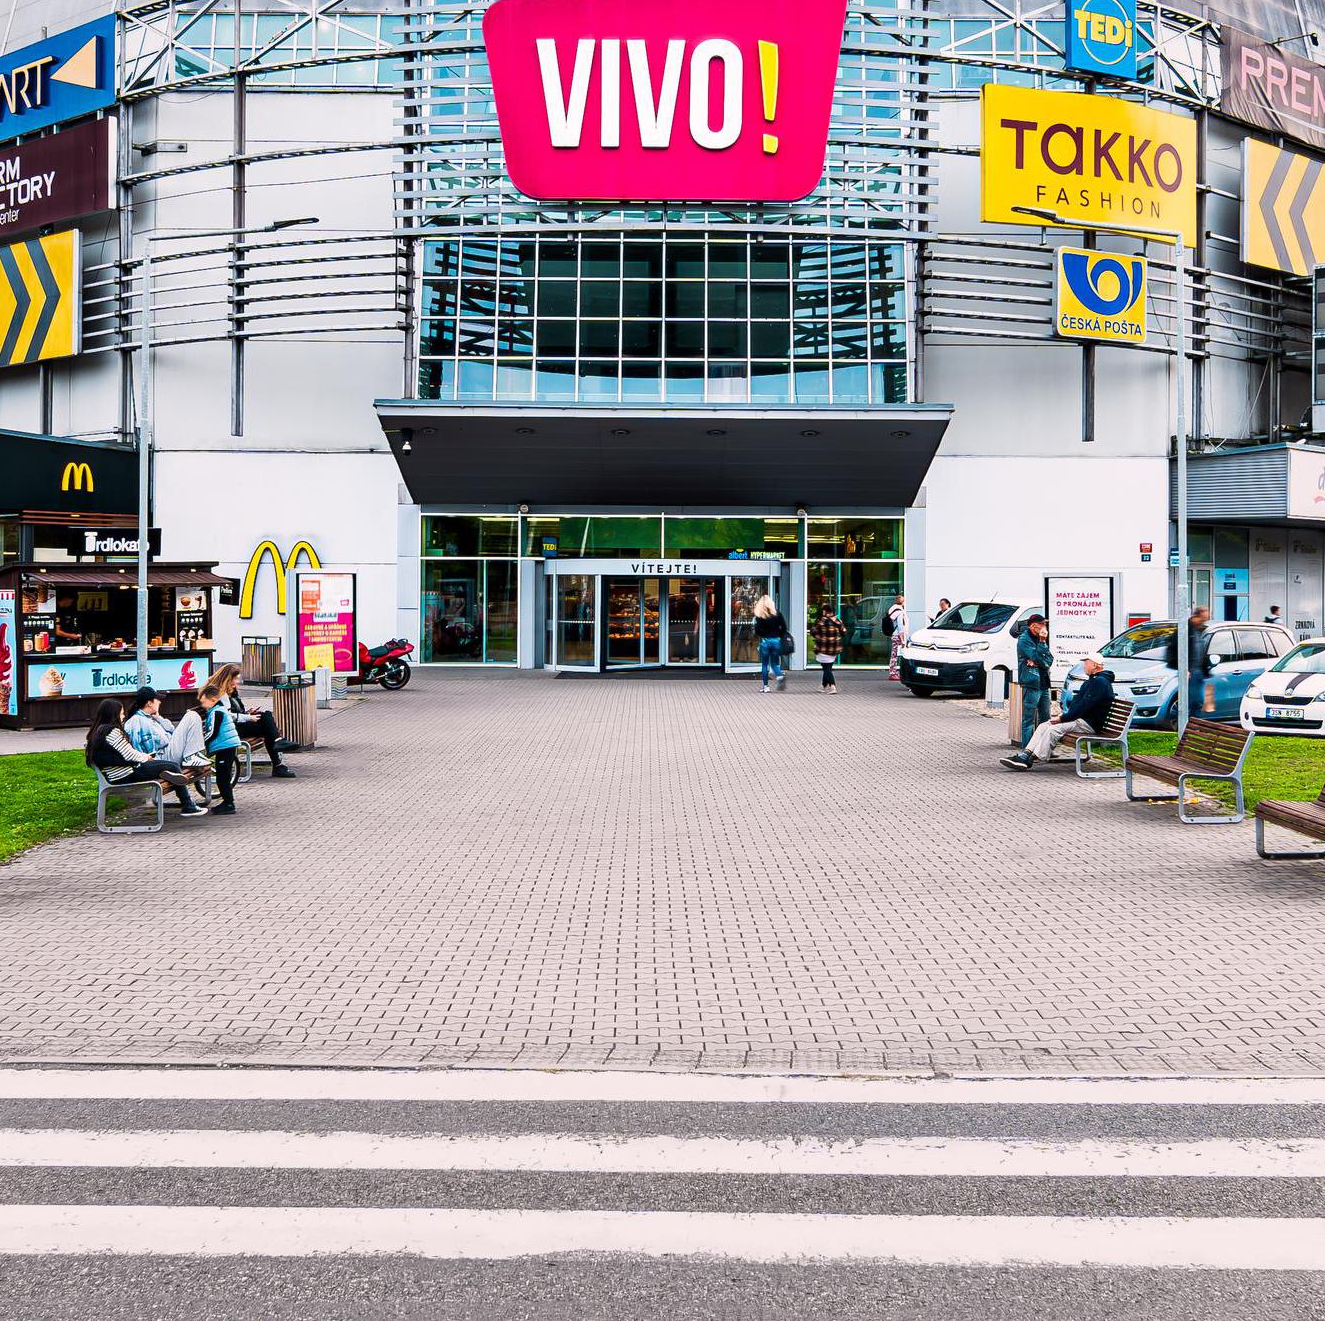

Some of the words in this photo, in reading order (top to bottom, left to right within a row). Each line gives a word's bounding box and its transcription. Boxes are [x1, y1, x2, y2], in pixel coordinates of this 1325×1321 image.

[1074, 9, 1132, 48] TEDi
[535, 39, 779, 154] VIVO!
[1036, 185, 1161, 219] FASHION
[1060, 314, 1101, 331] ČESKÁ
[1104, 318, 1143, 337] POŠTA
[631, 561, 697, 574] VÍTEJTE!
